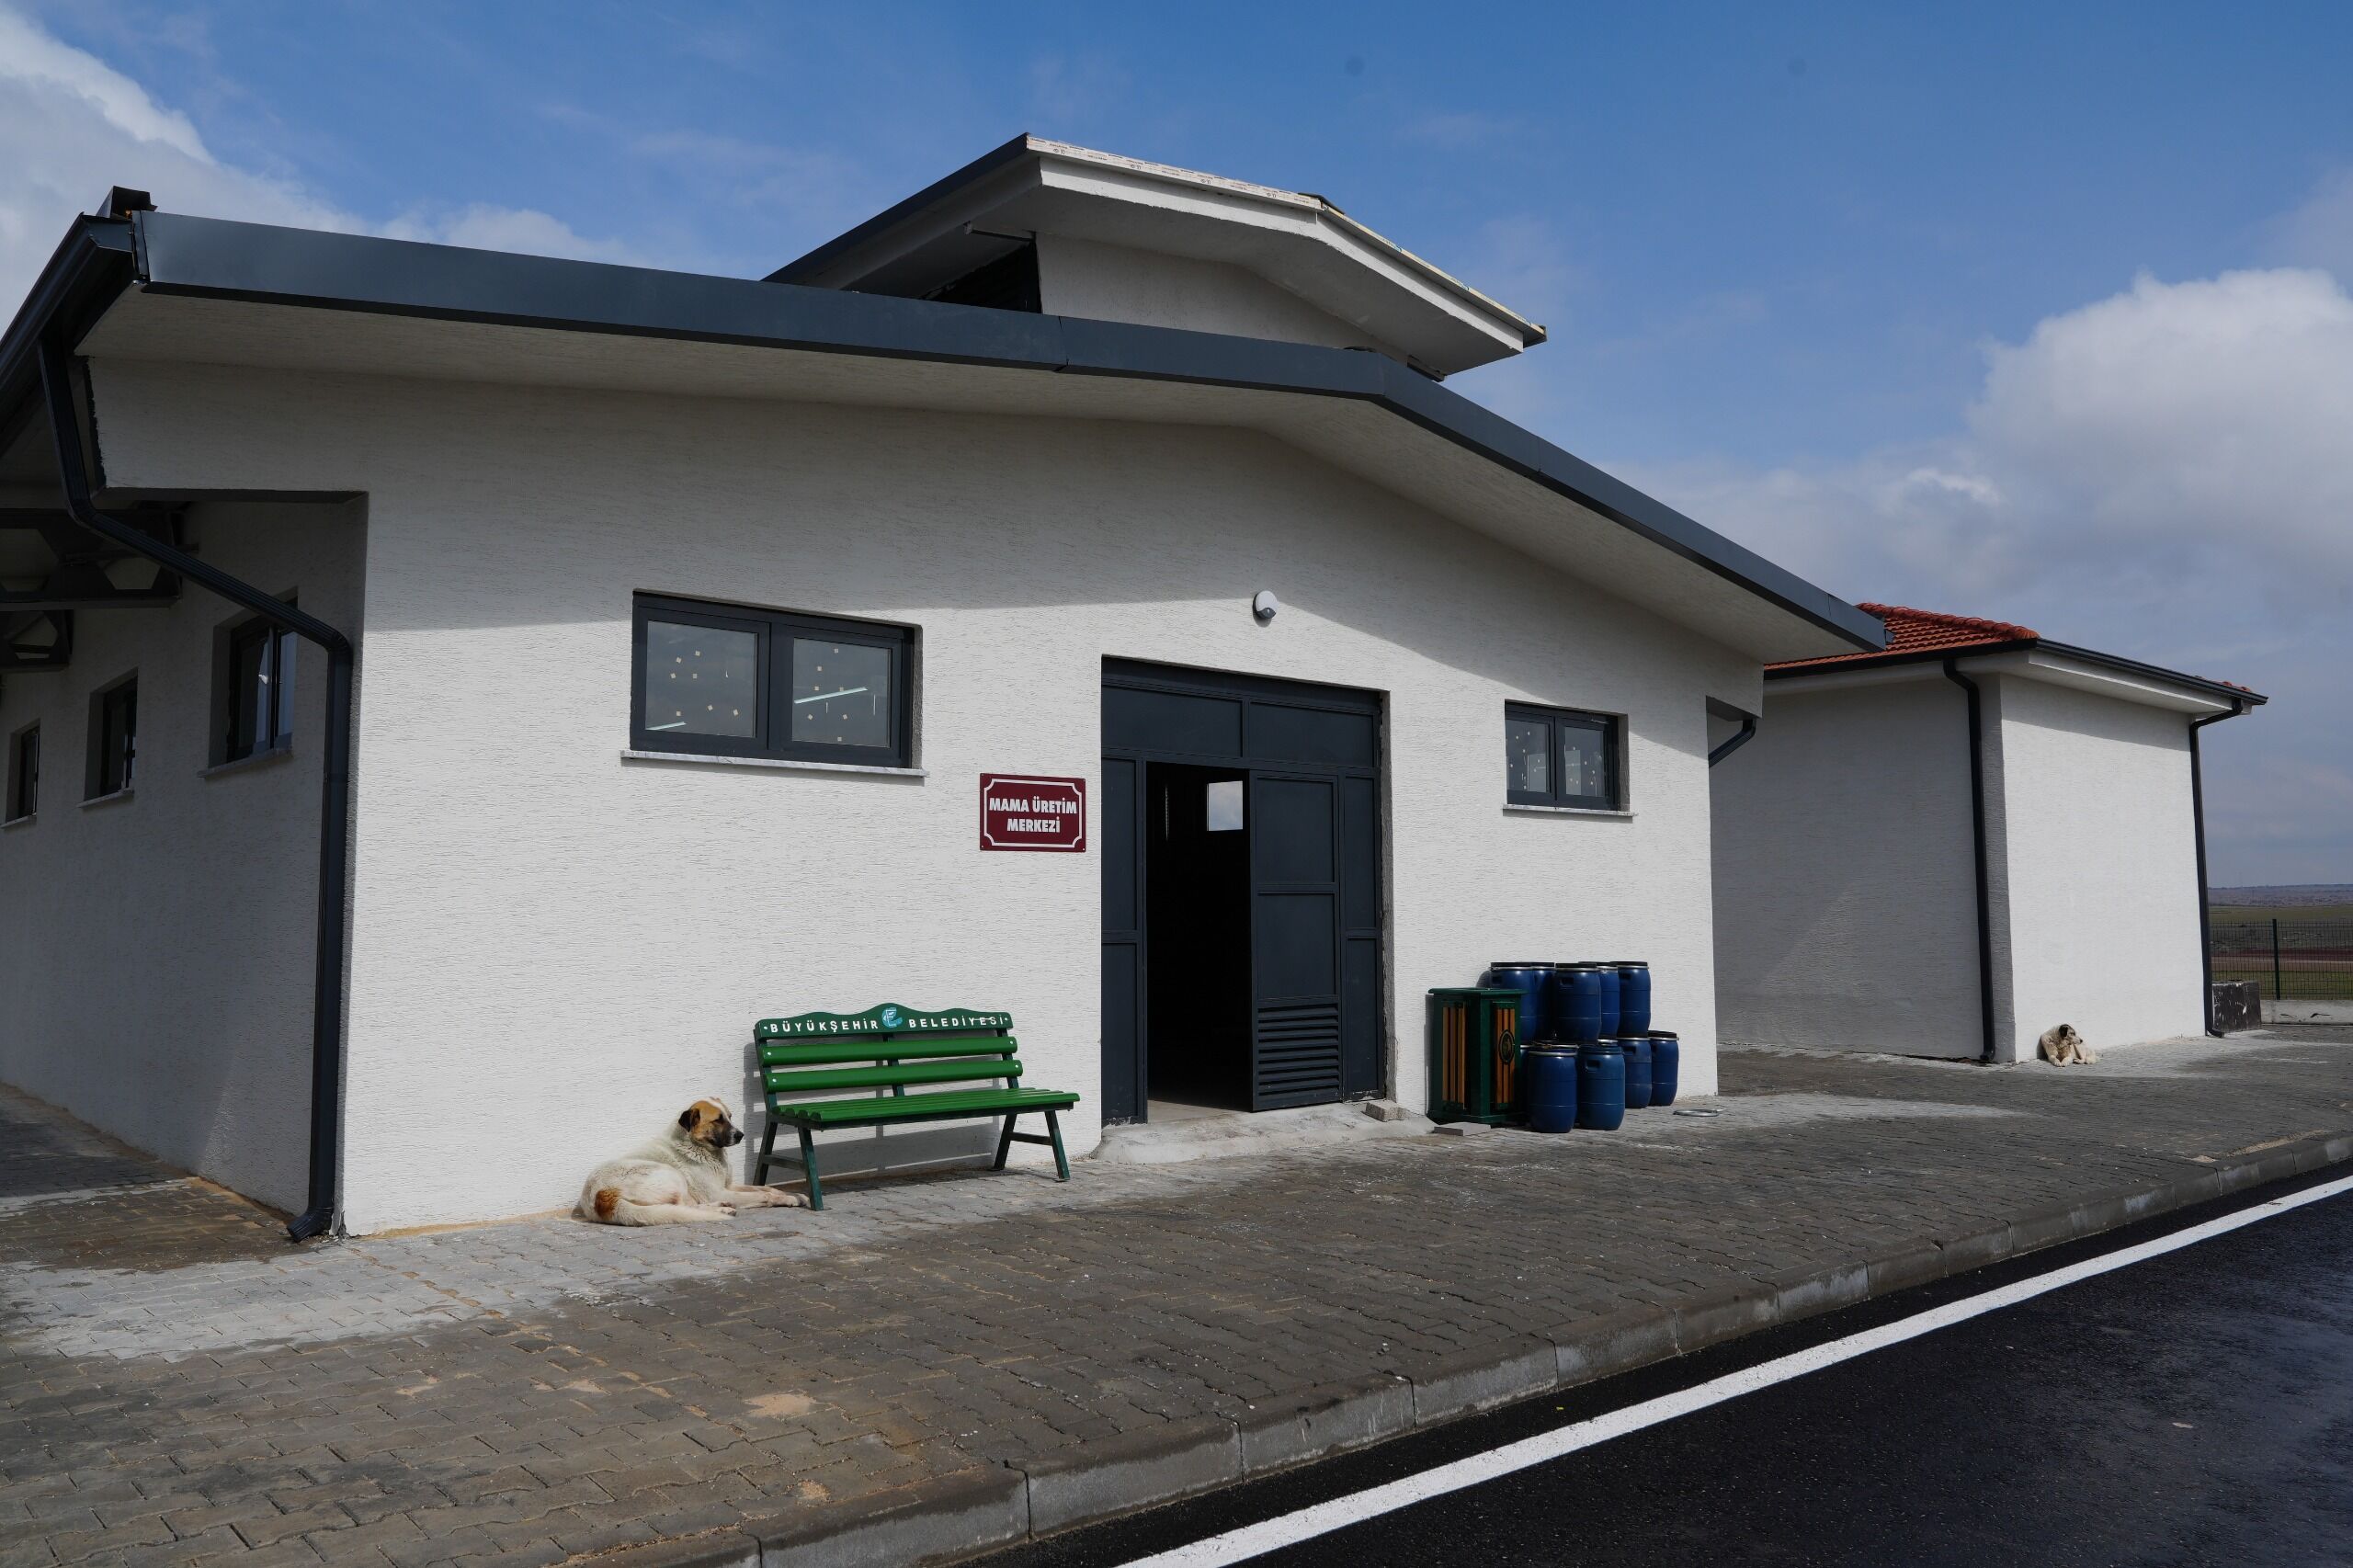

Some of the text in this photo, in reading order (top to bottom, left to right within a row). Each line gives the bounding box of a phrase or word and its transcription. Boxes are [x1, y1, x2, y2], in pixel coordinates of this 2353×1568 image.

[989, 795, 1077, 813] MAMA ÜRETİM
[1006, 816, 1061, 833] MERKEZİ
[770, 1014, 1004, 1033] BÜYÜKŞEHİR BELEDİYESİ
